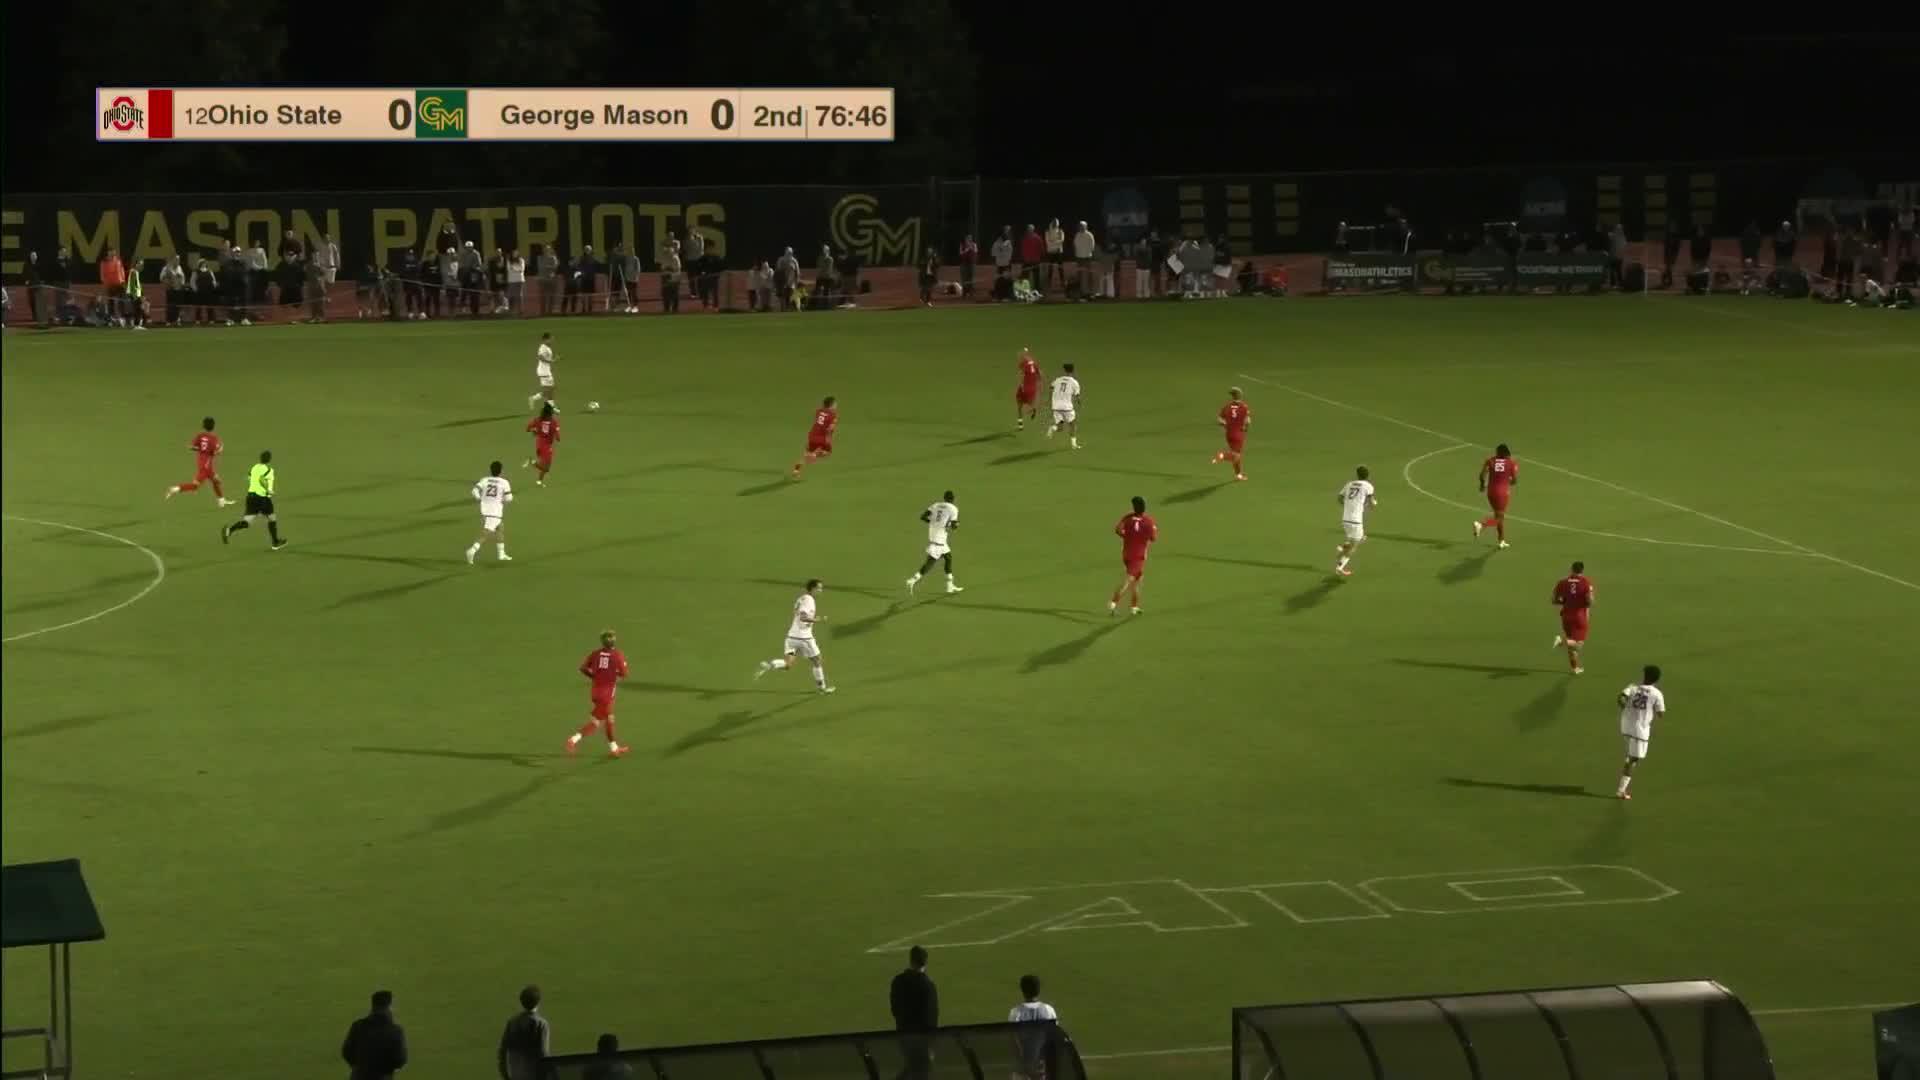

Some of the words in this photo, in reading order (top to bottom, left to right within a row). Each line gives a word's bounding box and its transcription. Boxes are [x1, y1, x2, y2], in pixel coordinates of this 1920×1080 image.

[57, 208, 341, 273] MASON
[372, 203, 727, 270] PATRIOTS
[486, 484, 497, 497] 23
